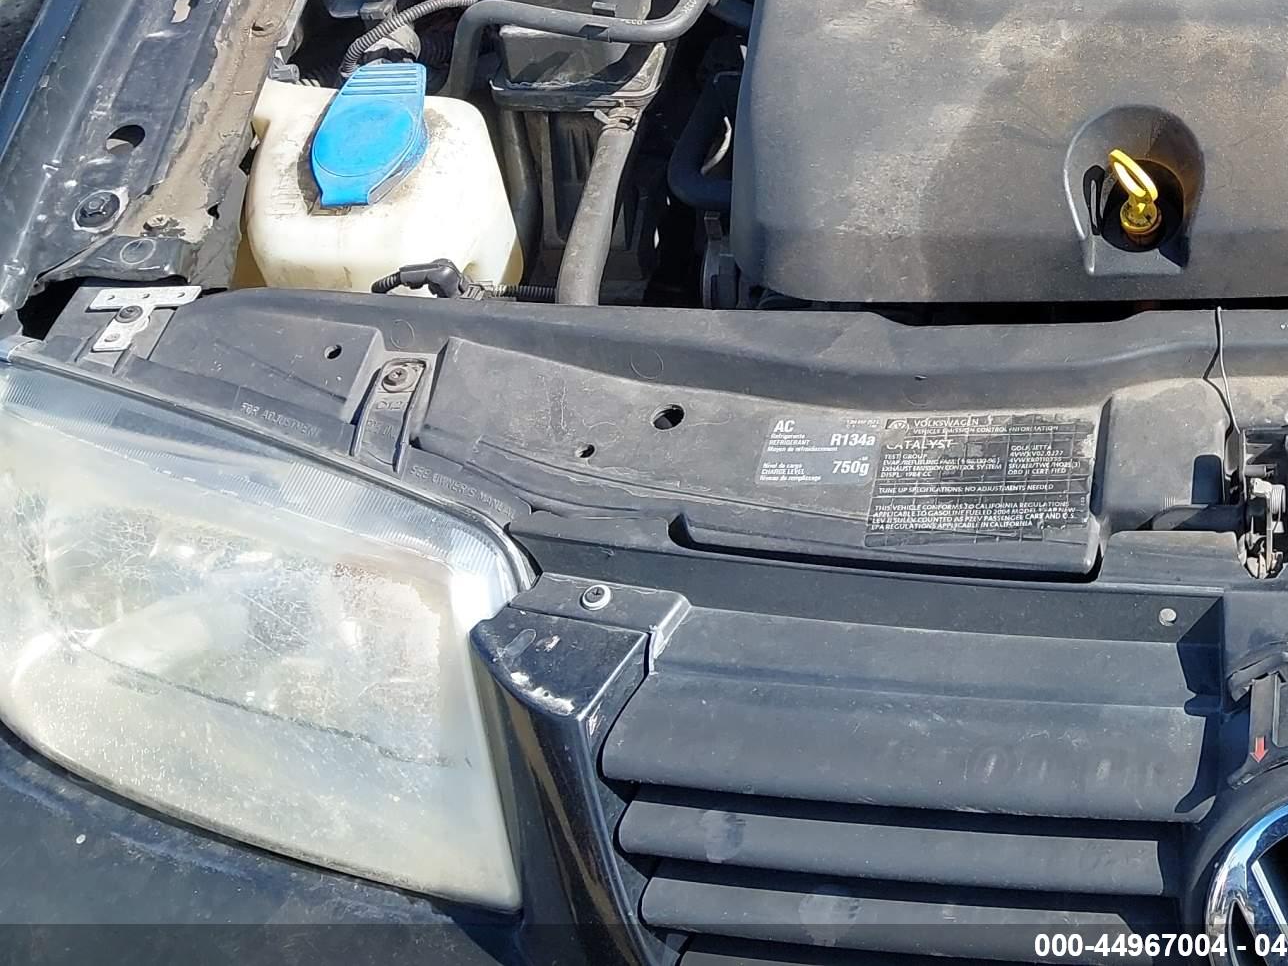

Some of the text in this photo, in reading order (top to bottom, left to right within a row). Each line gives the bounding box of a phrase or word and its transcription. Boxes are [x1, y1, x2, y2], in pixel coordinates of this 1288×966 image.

[240, 402, 260, 416] FOR
[773, 420, 795, 433] AC
[913, 417, 979, 428] VOLKSWAGEN
[830, 433, 876, 446] R134a
[832, 460, 870, 476] 750g
